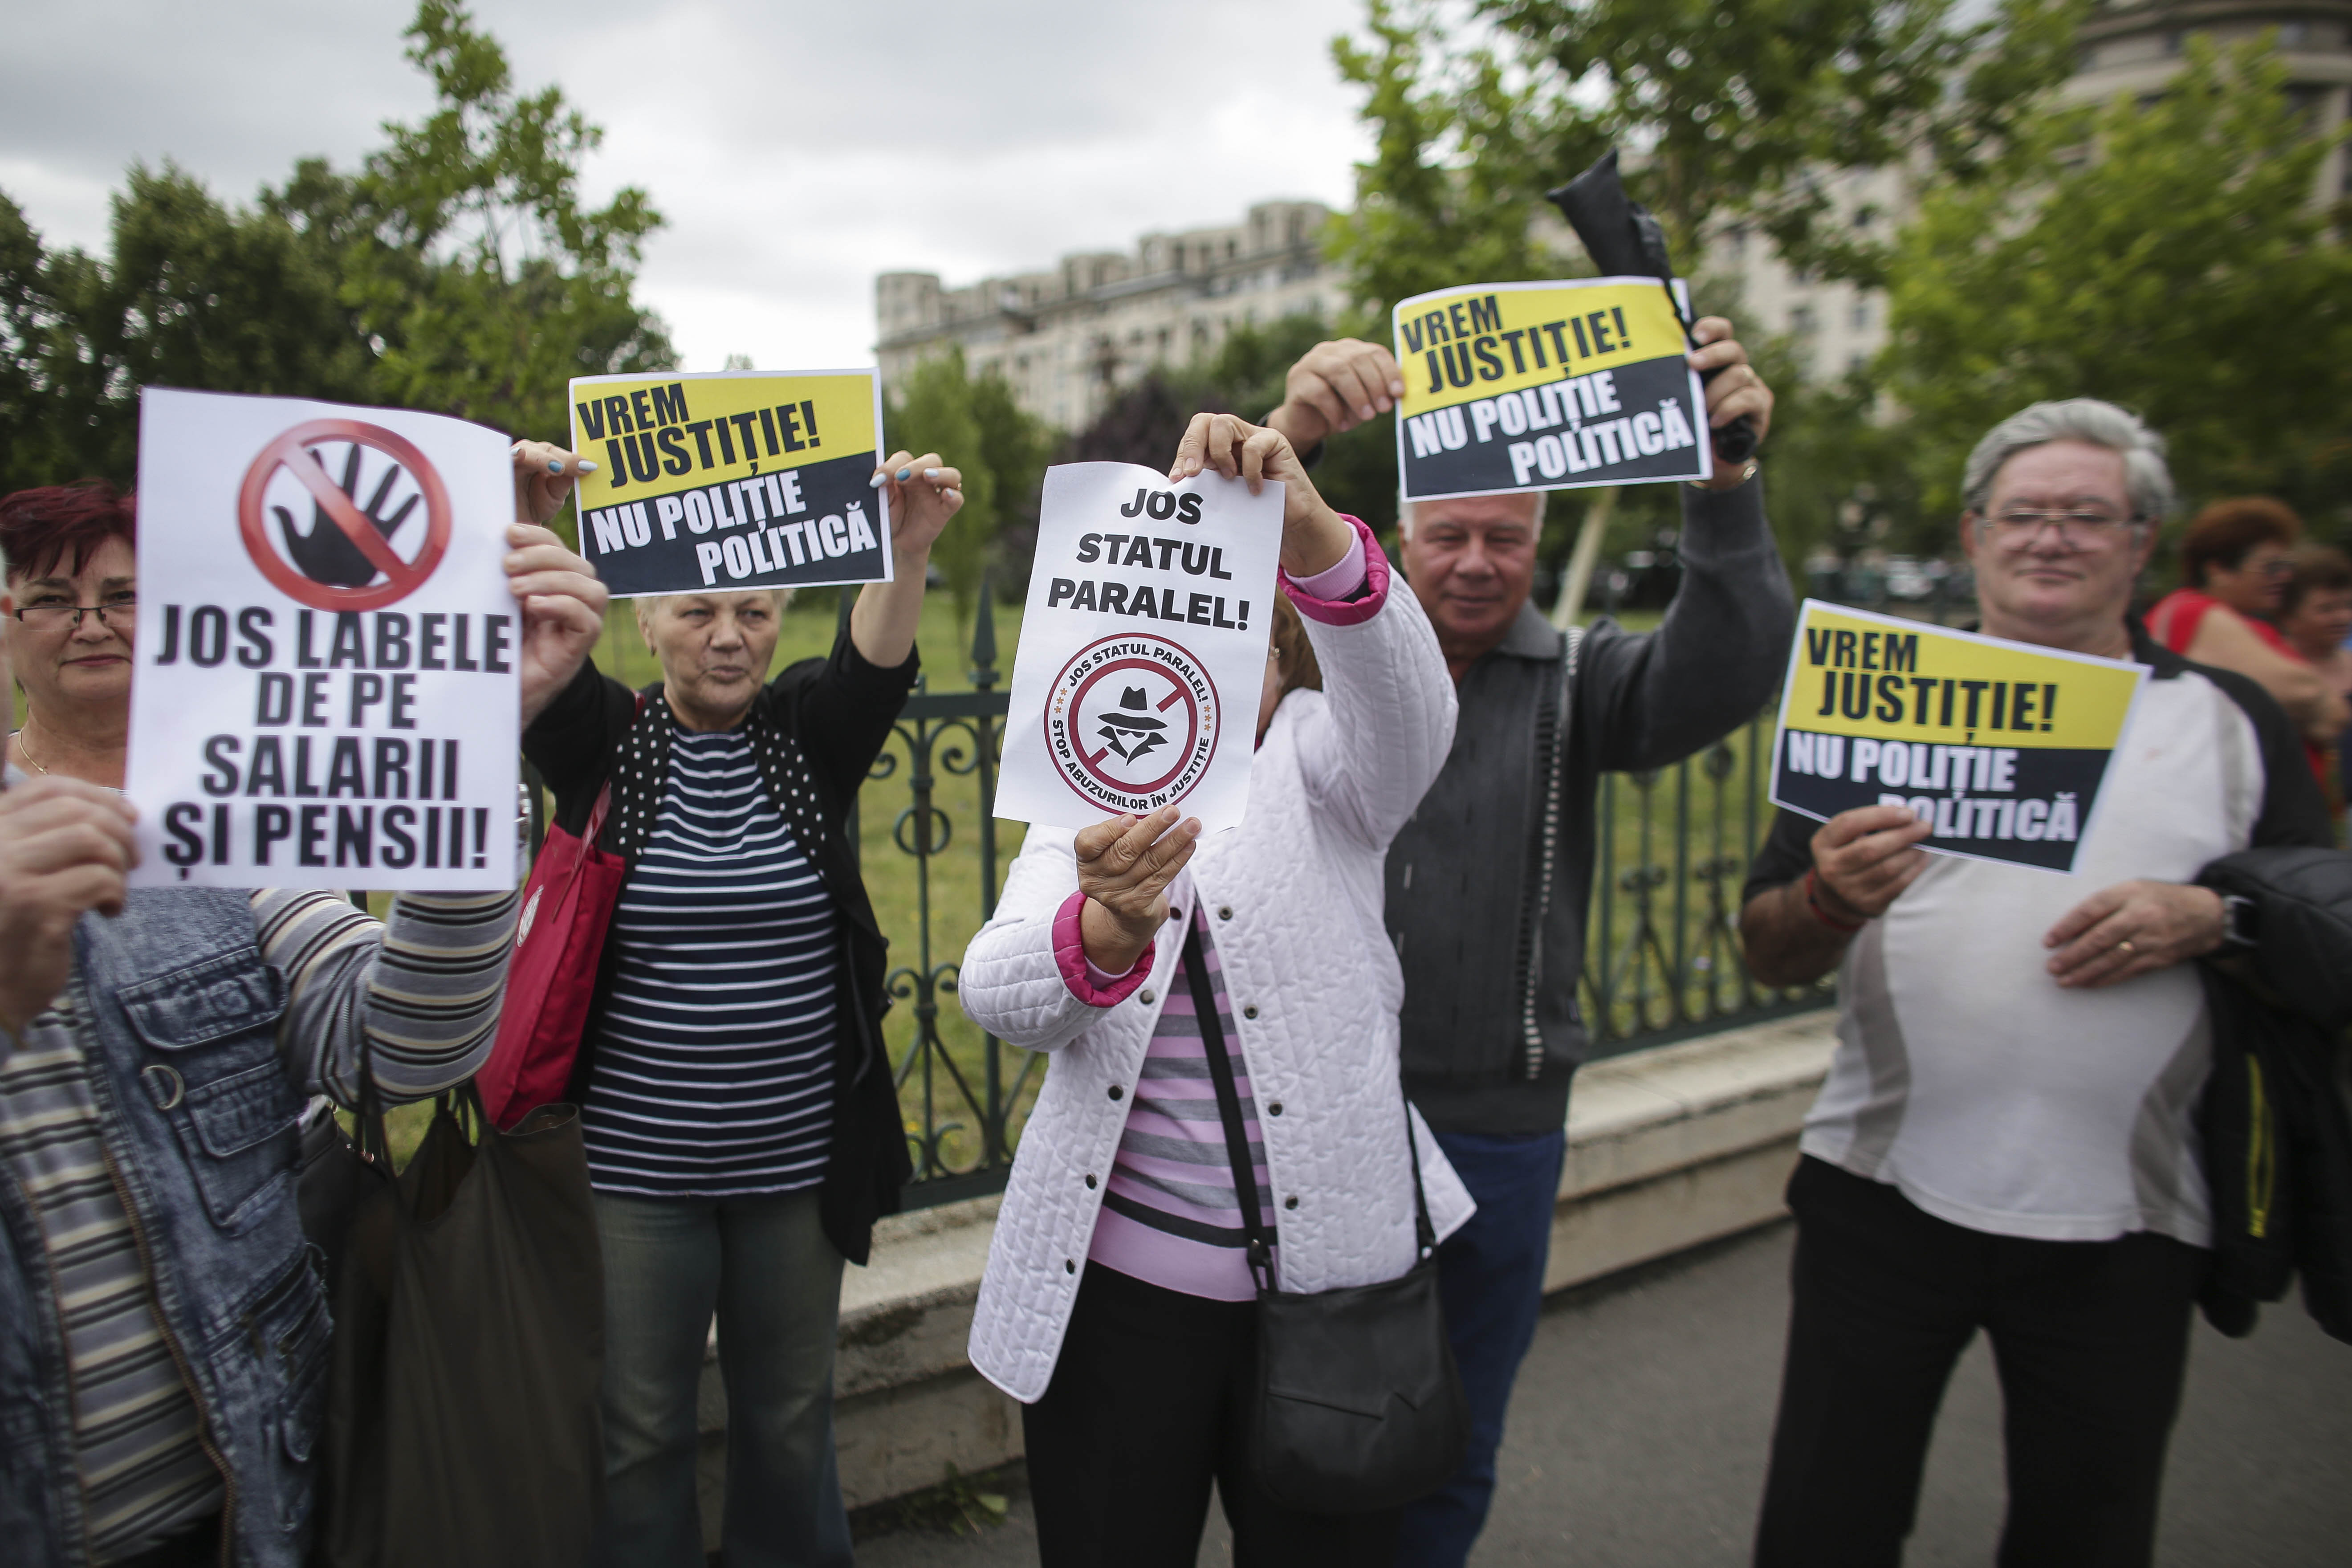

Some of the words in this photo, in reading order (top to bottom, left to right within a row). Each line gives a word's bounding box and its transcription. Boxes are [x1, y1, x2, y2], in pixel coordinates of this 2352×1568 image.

[1402, 295, 1503, 354] VREM
[1426, 307, 1632, 394] JUSTIȚIE!
[577, 383, 690, 441] VREM
[605, 400, 820, 489] JUSTIȚIE!
[1408, 405, 1469, 459] NU
[1469, 370, 1622, 443] POLIȚIE
[1508, 398, 1695, 486] POLITICĂ
[590, 501, 651, 555] NU
[655, 470, 806, 541] POLIȚIE
[1120, 489, 1204, 524] JOS
[696, 501, 877, 586] POLITICĂ
[1076, 534, 1232, 580] STATUL
[155, 604, 275, 669] JOS
[297, 608, 512, 674] LABELE
[1048, 578, 1249, 631] PARALEL!
[1069, 660, 1092, 687] JOS
[1092, 643, 1150, 664] STATUL
[1153, 647, 1208, 702] PARALEL!
[1807, 628, 1919, 673] VREM
[255, 672, 330, 728] DE
[351, 673, 417, 730] PE
[1818, 671, 2059, 745] JUSTIȚIE!
[199, 734, 461, 801] SALARII
[1053, 720, 1070, 759] STOP
[1065, 762, 1149, 810] ABUZURILOR
[1150, 793, 1167, 808] ÎN
[1169, 737, 1209, 798] JUSTIȚIE
[1787, 731, 1845, 780] NU
[1851, 737, 2019, 800] POLIȚIE
[162, 801, 231, 880] ȘI
[255, 806, 490, 868] PENSII!
